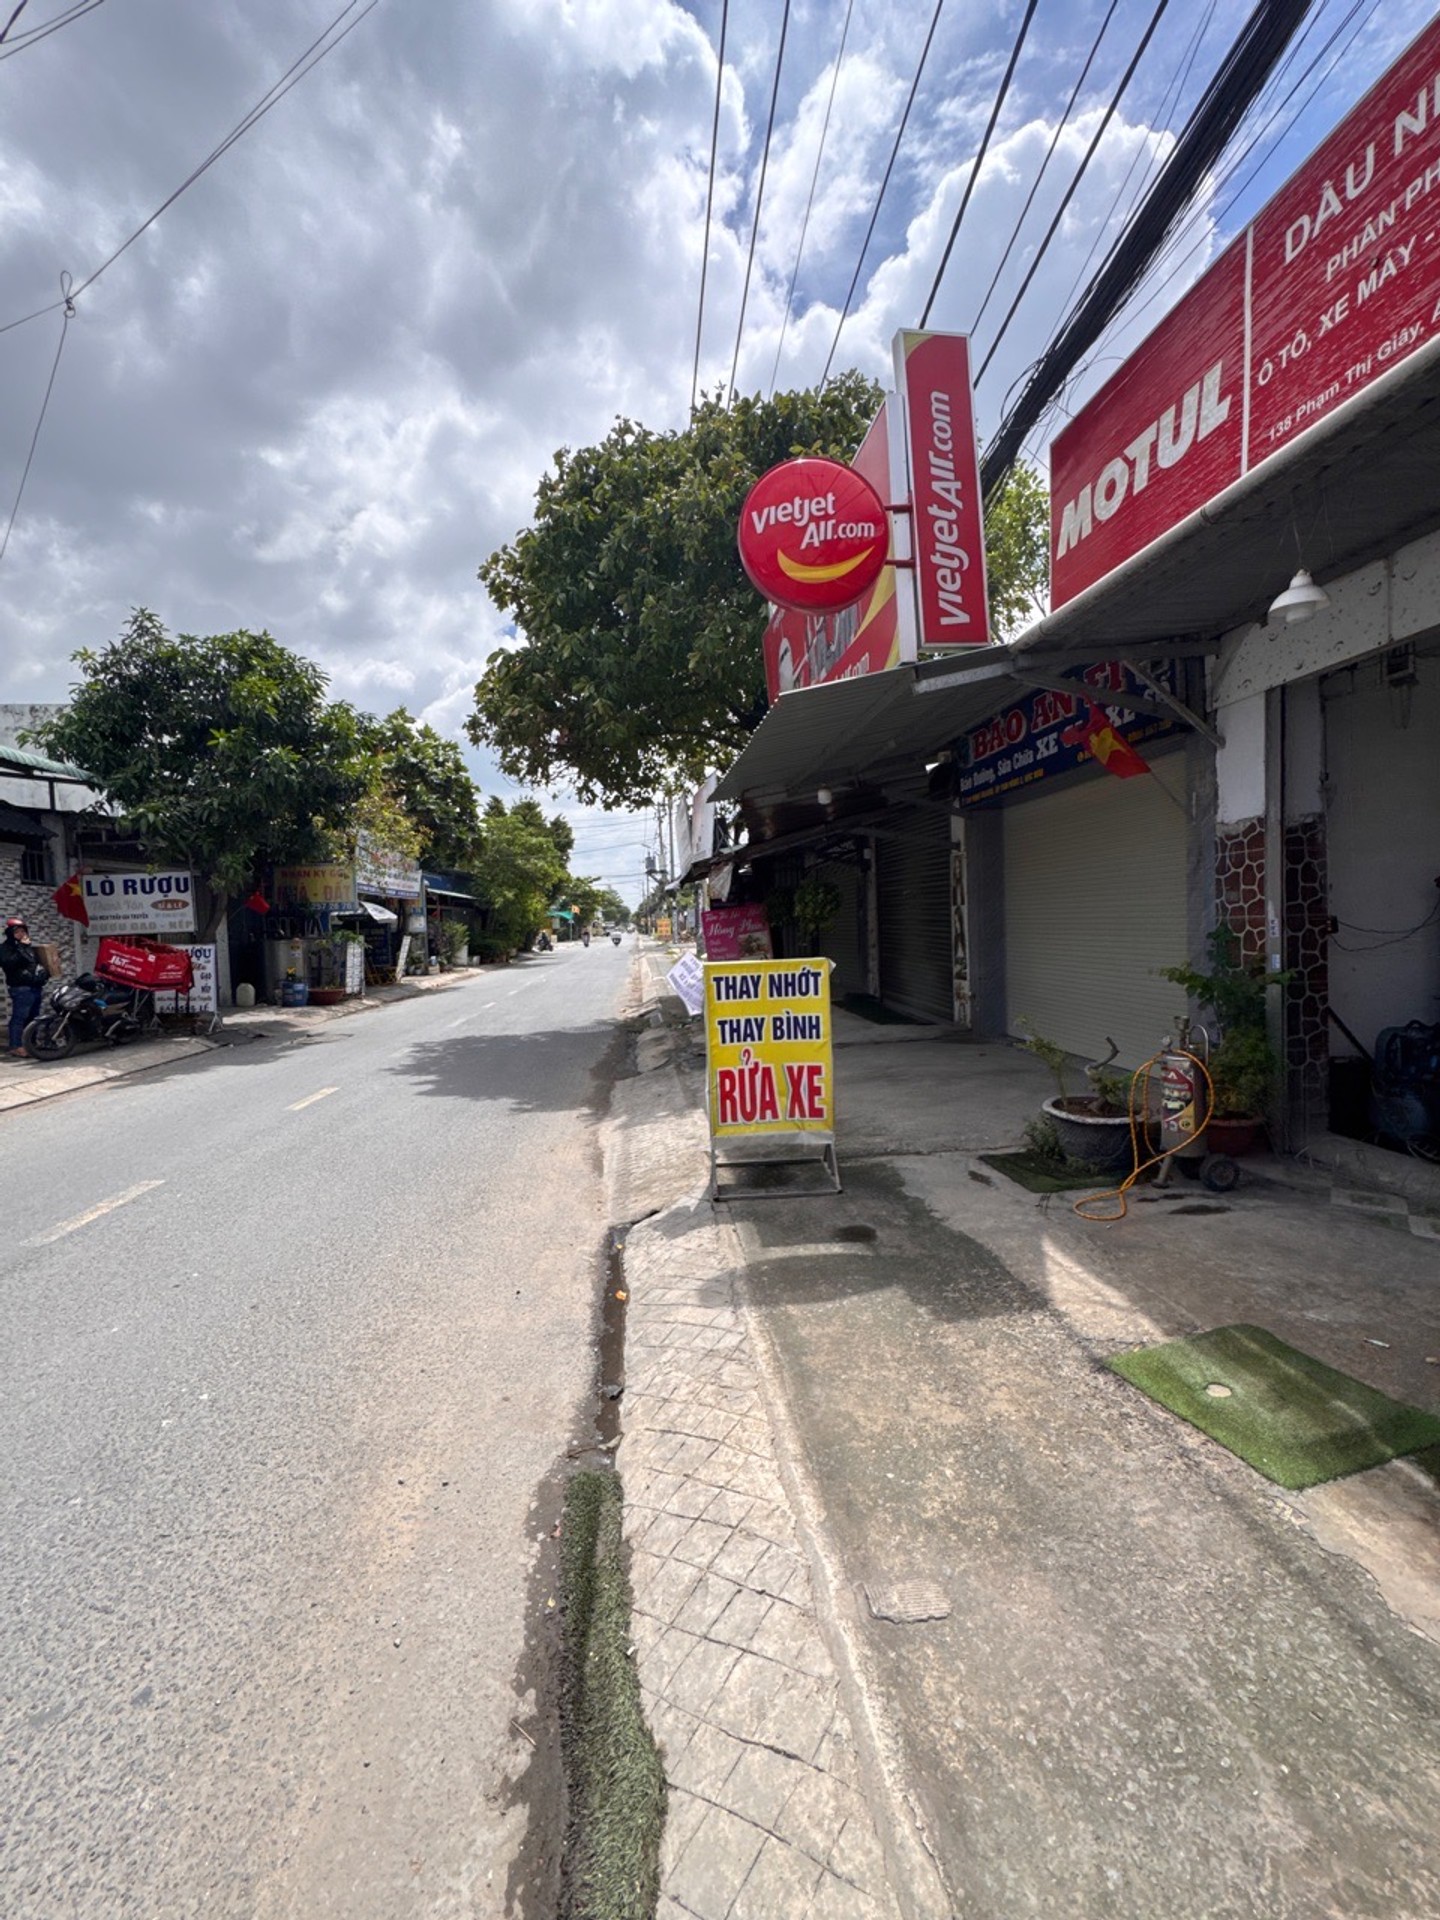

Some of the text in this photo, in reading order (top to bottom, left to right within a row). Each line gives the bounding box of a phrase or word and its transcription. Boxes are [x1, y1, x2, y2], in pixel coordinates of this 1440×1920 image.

[1258, 357, 1273, 386] Ô
[1318, 293, 1350, 338] XE
[1356, 235, 1417, 306] MÁY
[1268, 415, 1292, 442] 138
[1296, 382, 1340, 422] Phạm
[1344, 354, 1372, 385] Thị
[1056, 361, 1232, 561] MOTUL
[1036, 730, 1059, 761] XE
[86, 875, 190, 898] LÒ RƯỢU
[713, 974, 762, 1001] THAY
[768, 967, 823, 998] NHỚT
[717, 1010, 821, 1044] THAY BÌNH
[718, 1047, 824, 1124] RỬA XE
